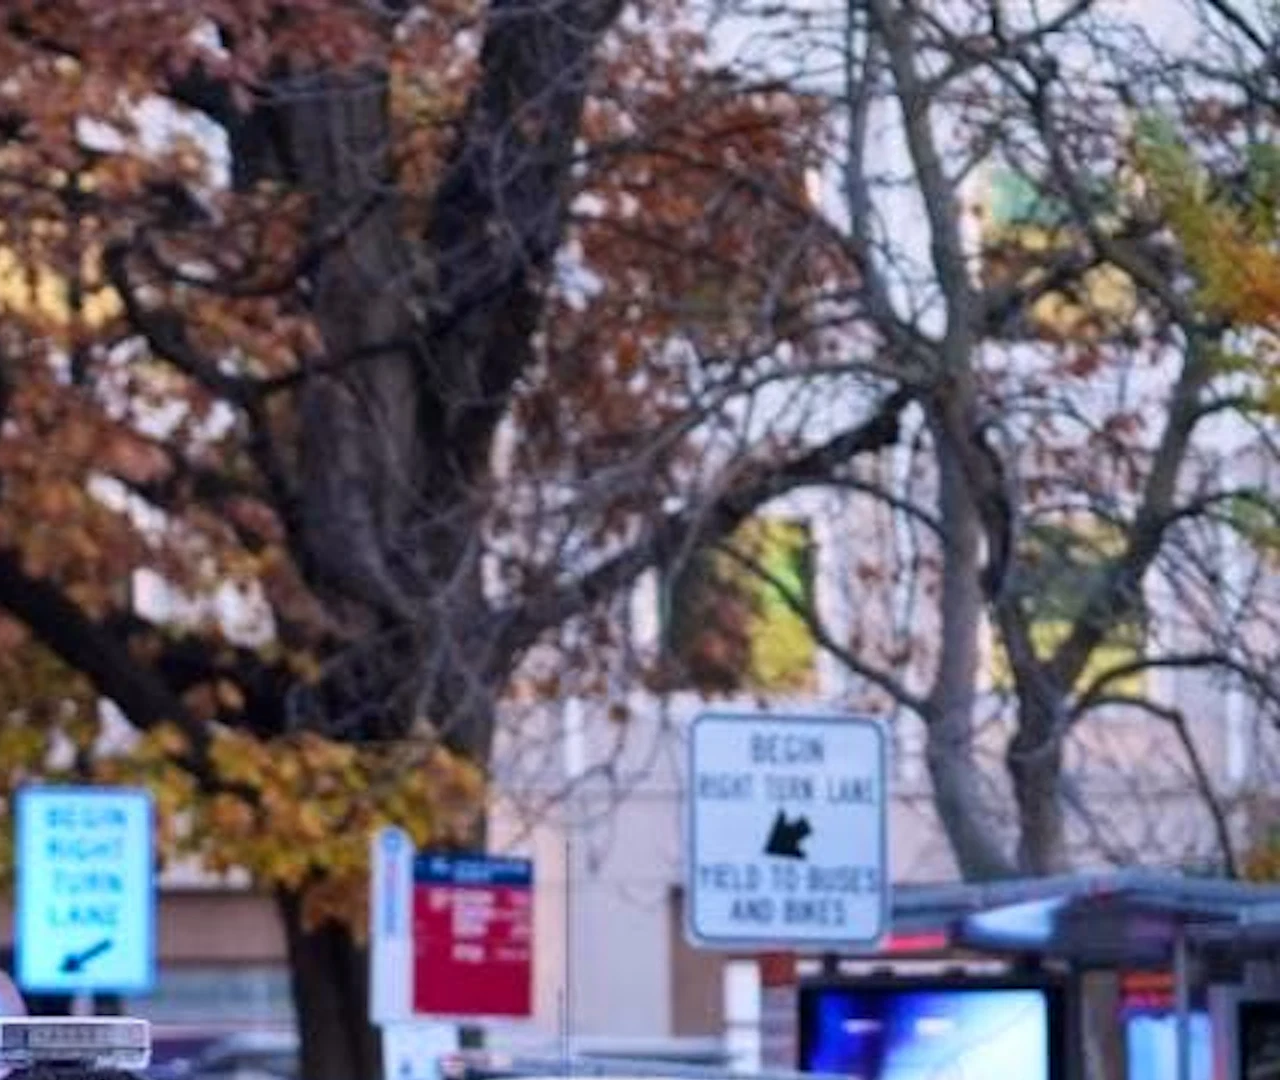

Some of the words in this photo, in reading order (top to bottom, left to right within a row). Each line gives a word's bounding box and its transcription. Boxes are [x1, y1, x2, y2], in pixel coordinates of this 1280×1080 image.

[752, 733, 825, 763] BEGIN
[700, 774, 752, 799] RIGHT
[765, 774, 813, 801] TURN
[827, 776, 875, 804] LANE
[47, 808, 129, 830] BEGIN
[47, 837, 124, 861] RIGHT
[52, 868, 124, 893] TURN
[700, 864, 761, 892] YIELD
[771, 864, 802, 893] TO
[807, 866, 880, 895] BUSES
[47, 904, 119, 928] LANE
[730, 898, 775, 925] AND
[783, 899, 847, 927] BIKES
